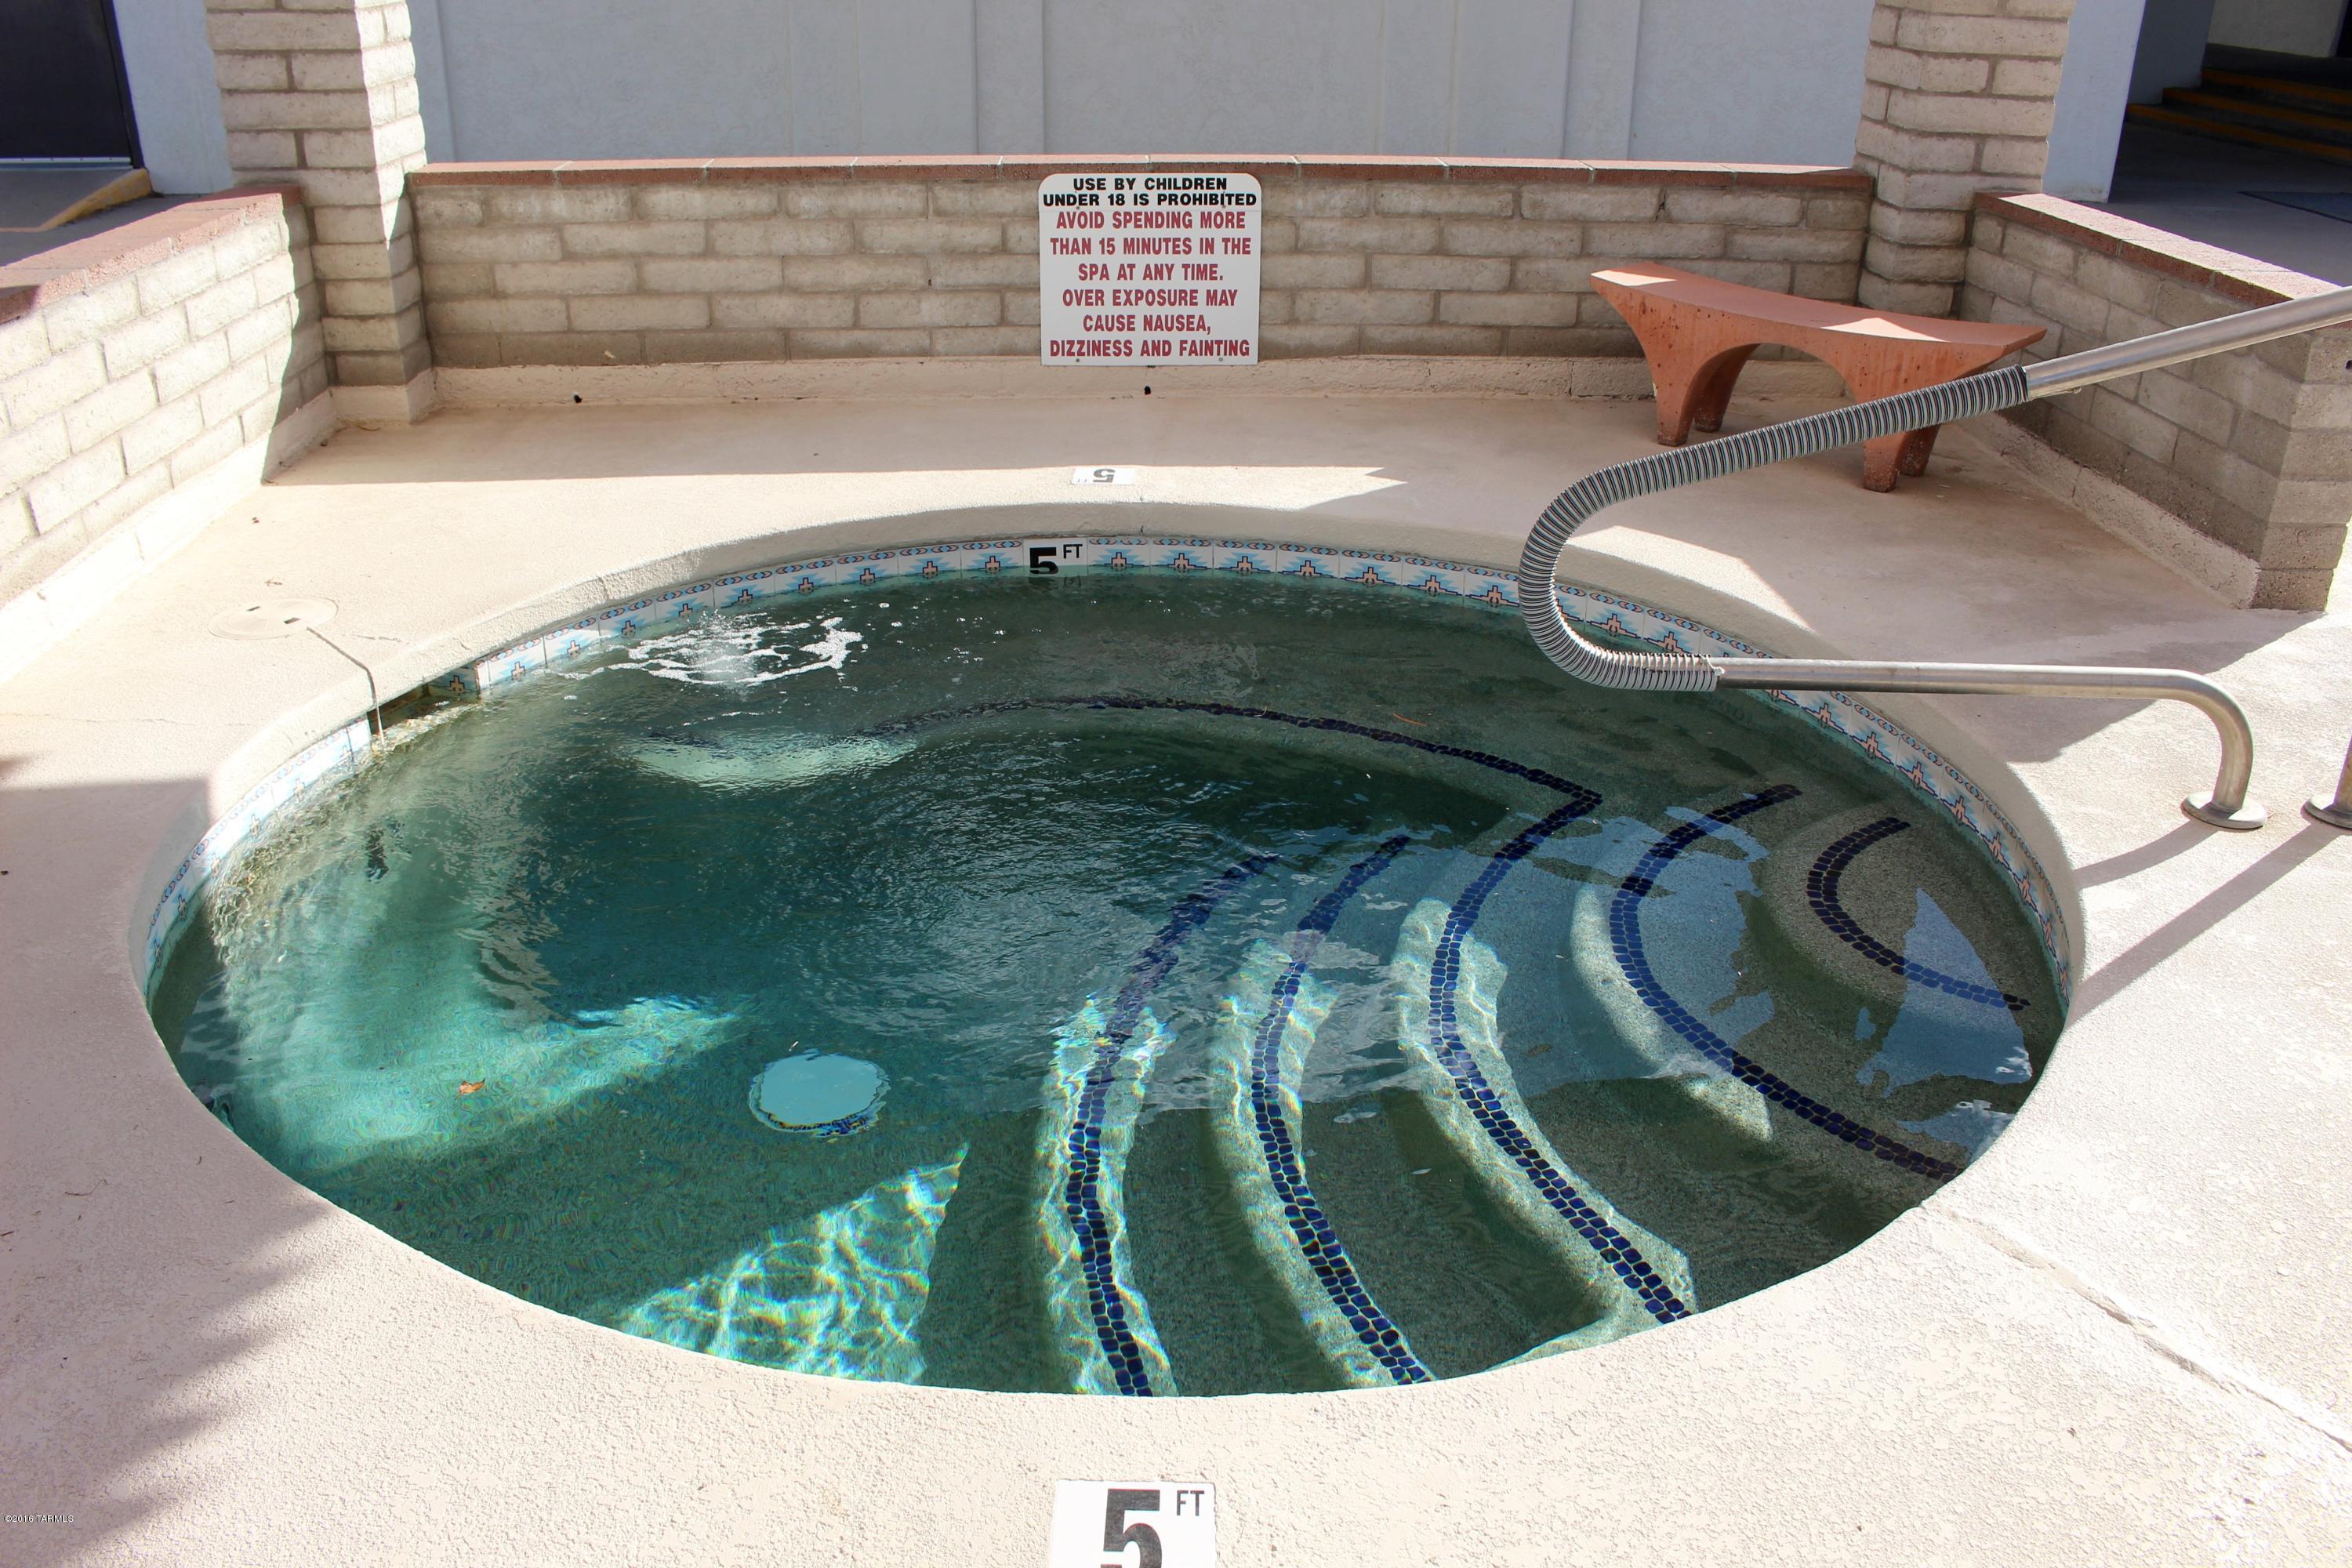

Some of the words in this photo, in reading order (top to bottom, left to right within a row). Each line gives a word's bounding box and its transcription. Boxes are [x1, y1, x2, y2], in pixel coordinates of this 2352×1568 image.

[1073, 178, 1106, 190] USE
[1114, 178, 1136, 190] BY
[1145, 178, 1227, 190] CHILDREN
[1044, 194, 1099, 206] UNDER
[1108, 194, 1125, 206] 18
[1134, 194, 1149, 205] IS
[1157, 194, 1257, 205] PROHIBITED
[1057, 212, 1105, 229] AVOID
[1112, 212, 1192, 229] SPENDING
[1200, 212, 1246, 228] MORE
[1051, 238, 1091, 255] THAN
[1099, 238, 1115, 254] 15
[1123, 238, 1192, 255] MINUTES
[1200, 238, 1214, 254] IN
[1222, 238, 1251, 255] THE
[1078, 264, 1109, 281] SPA
[1117, 264, 1135, 281] AT
[1143, 264, 1174, 281] ANY
[1181, 264, 1223, 281] TIME.
[1062, 289, 1105, 306] OVER
[1112, 289, 1198, 306] EXPOSURE
[1206, 289, 1237, 306] MAY
[1083, 315, 1135, 332] CAUSE
[1143, 315, 1210, 335] NAUSEA,
[1050, 340, 1133, 356] DIZZINESS
[1140, 340, 1172, 356] AND
[1179, 339, 1250, 356] FAINTING
[1093, 468, 1116, 483] 5
[1029, 546, 1058, 575] 5
[1063, 543, 1083, 559] FT
[1101, 1489, 1162, 1568] 5
[1176, 1490, 1204, 1516] FT
